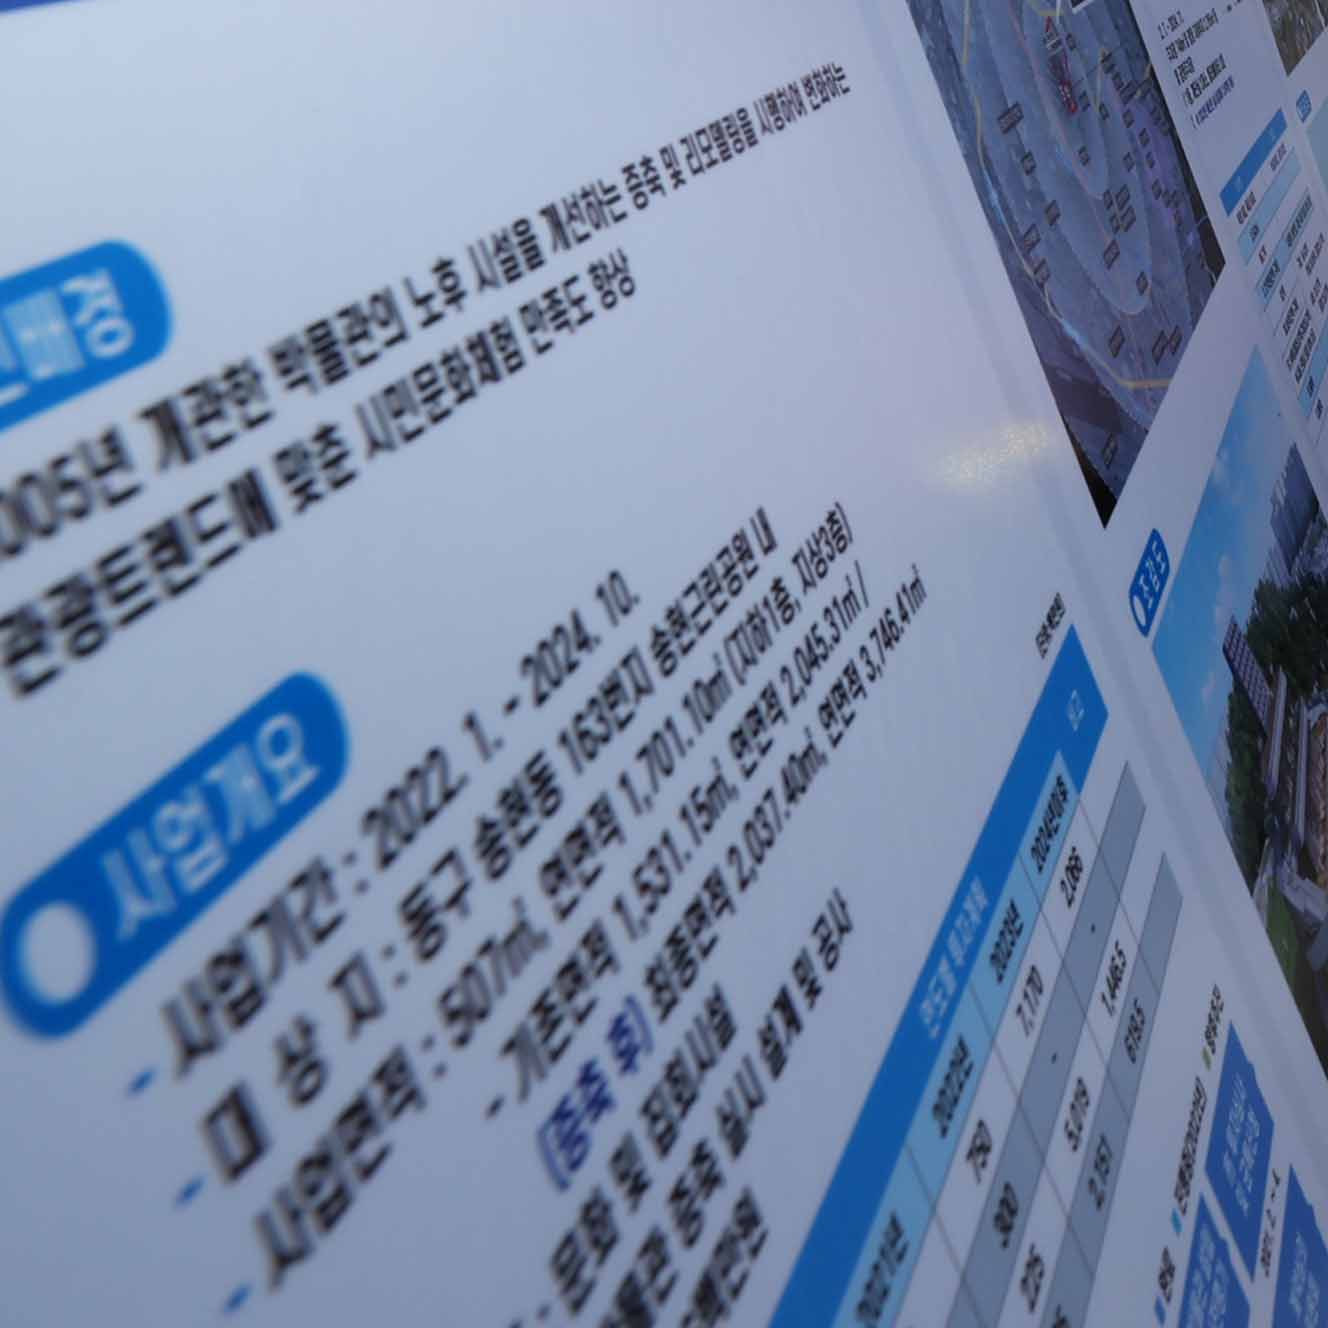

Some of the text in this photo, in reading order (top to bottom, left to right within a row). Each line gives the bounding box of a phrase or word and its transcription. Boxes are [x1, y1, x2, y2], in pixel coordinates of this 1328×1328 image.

[136, 356, 276, 471] 개관한
[268, 284, 410, 395] 박물관의
[403, 257, 468, 328] 노후
[467, 218, 546, 293] 시설을
[539, 179, 628, 252] 개선하는
[621, 155, 667, 211] 증축
[658, 144, 687, 190] 및
[679, 107, 759, 176] 리모델링을
[753, 81, 808, 135] 시행하여
[801, 61, 851, 111] 변화하는
[272, 423, 359, 515] 맞춘
[354, 317, 526, 460] 시민문화체험
[519, 275, 595, 355] 만족도
[588, 247, 636, 310] 향상
[100, 712, 322, 943] 사업개요
[161, 854, 347, 1080] 사업기간
[462, 710, 503, 762] 1.
[520, 609, 602, 709] 2024.
[596, 570, 640, 628] 10.
[398, 847, 474, 964] 동구
[474, 749, 564, 883] 송현동
[557, 645, 655, 776] 163번지
[650, 527, 761, 679] 송현근린공원
[750, 505, 778, 557] 내
[728, 679, 789, 782] 연면적
[815, 657, 869, 751] 연면적
[252, 1042, 429, 1297] 사업면적
[538, 790, 627, 924] 연면적
[792, 500, 853, 596] 지상3층)
[791, 945, 825, 1012] 및
[810, 885, 855, 975] 공사
